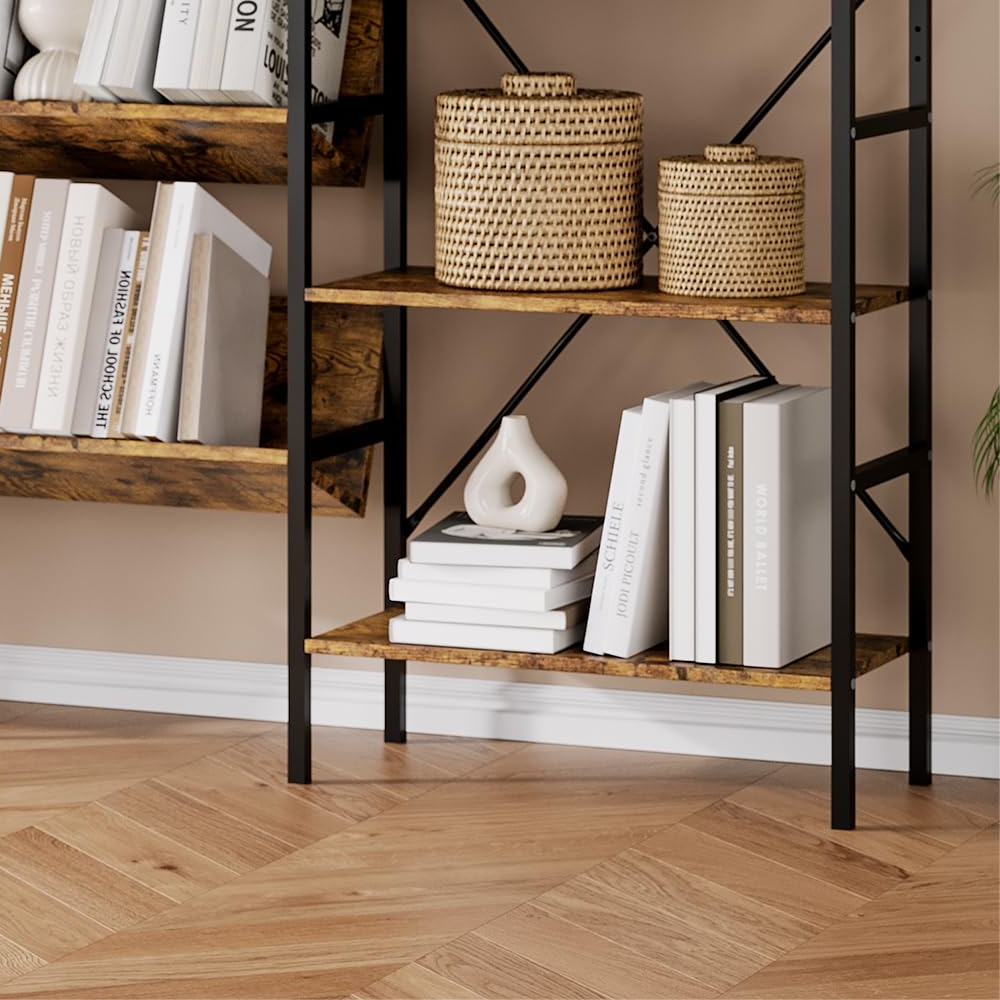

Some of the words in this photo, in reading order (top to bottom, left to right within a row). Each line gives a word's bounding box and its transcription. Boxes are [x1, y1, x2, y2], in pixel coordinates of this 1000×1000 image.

[65, 215, 87, 275] НОВЫЙ
[56, 279, 76, 332] ОБРАЗ
[47, 336, 67, 399] ЖИЗНИ
[602, 502, 625, 572] SCHIELE
[620, 529, 640, 586] PICOULT
[615, 588, 632, 619] JODI
